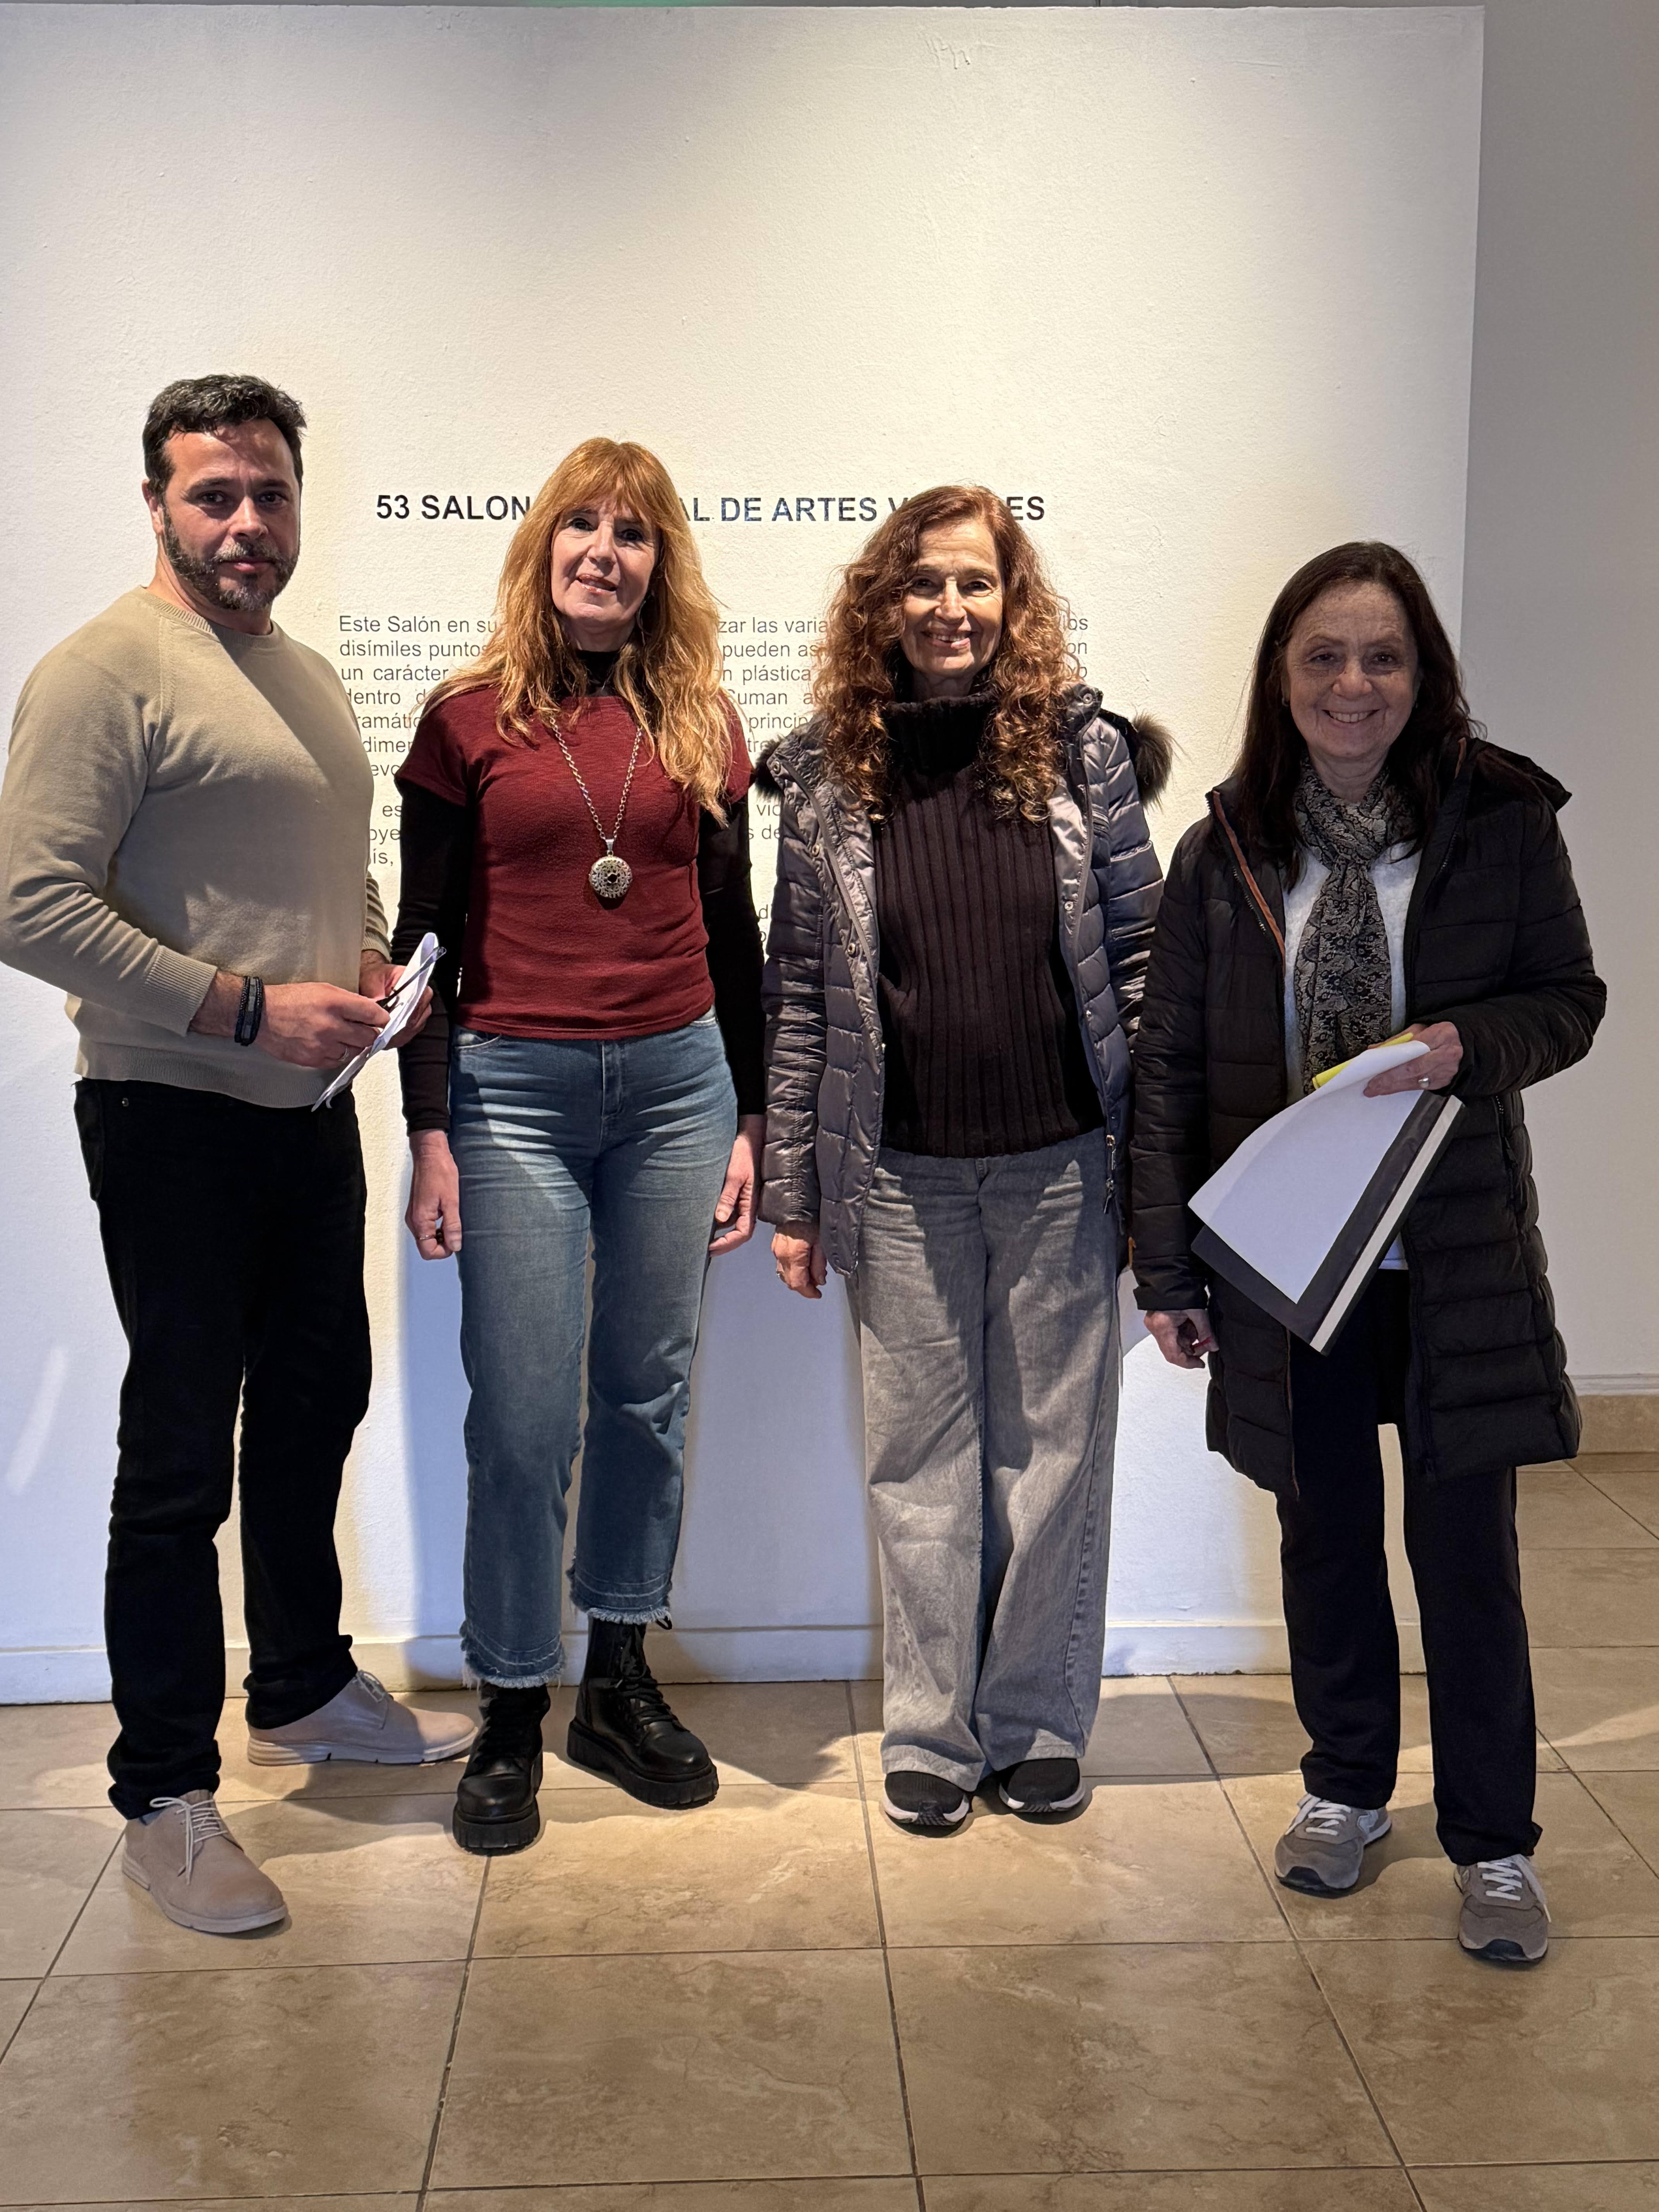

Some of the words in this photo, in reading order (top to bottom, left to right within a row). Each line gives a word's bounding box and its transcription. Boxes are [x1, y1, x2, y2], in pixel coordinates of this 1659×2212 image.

[376, 495, 410, 519] 53
[421, 495, 530, 520] SALON
[721, 497, 762, 521] DE
[771, 497, 877, 522] ARTES
[339, 615, 380, 632] Este
[388, 615, 440, 633] Salón
[448, 620, 469, 633] en
[753, 617, 778, 633] las
[340, 639, 421, 656] disímiles
[723, 641, 790, 661] pueden
[341, 668, 363, 680] un
[373, 664, 448, 681] carácter
[742, 665, 811, 685] plástica
[728, 689, 787, 705] uman
